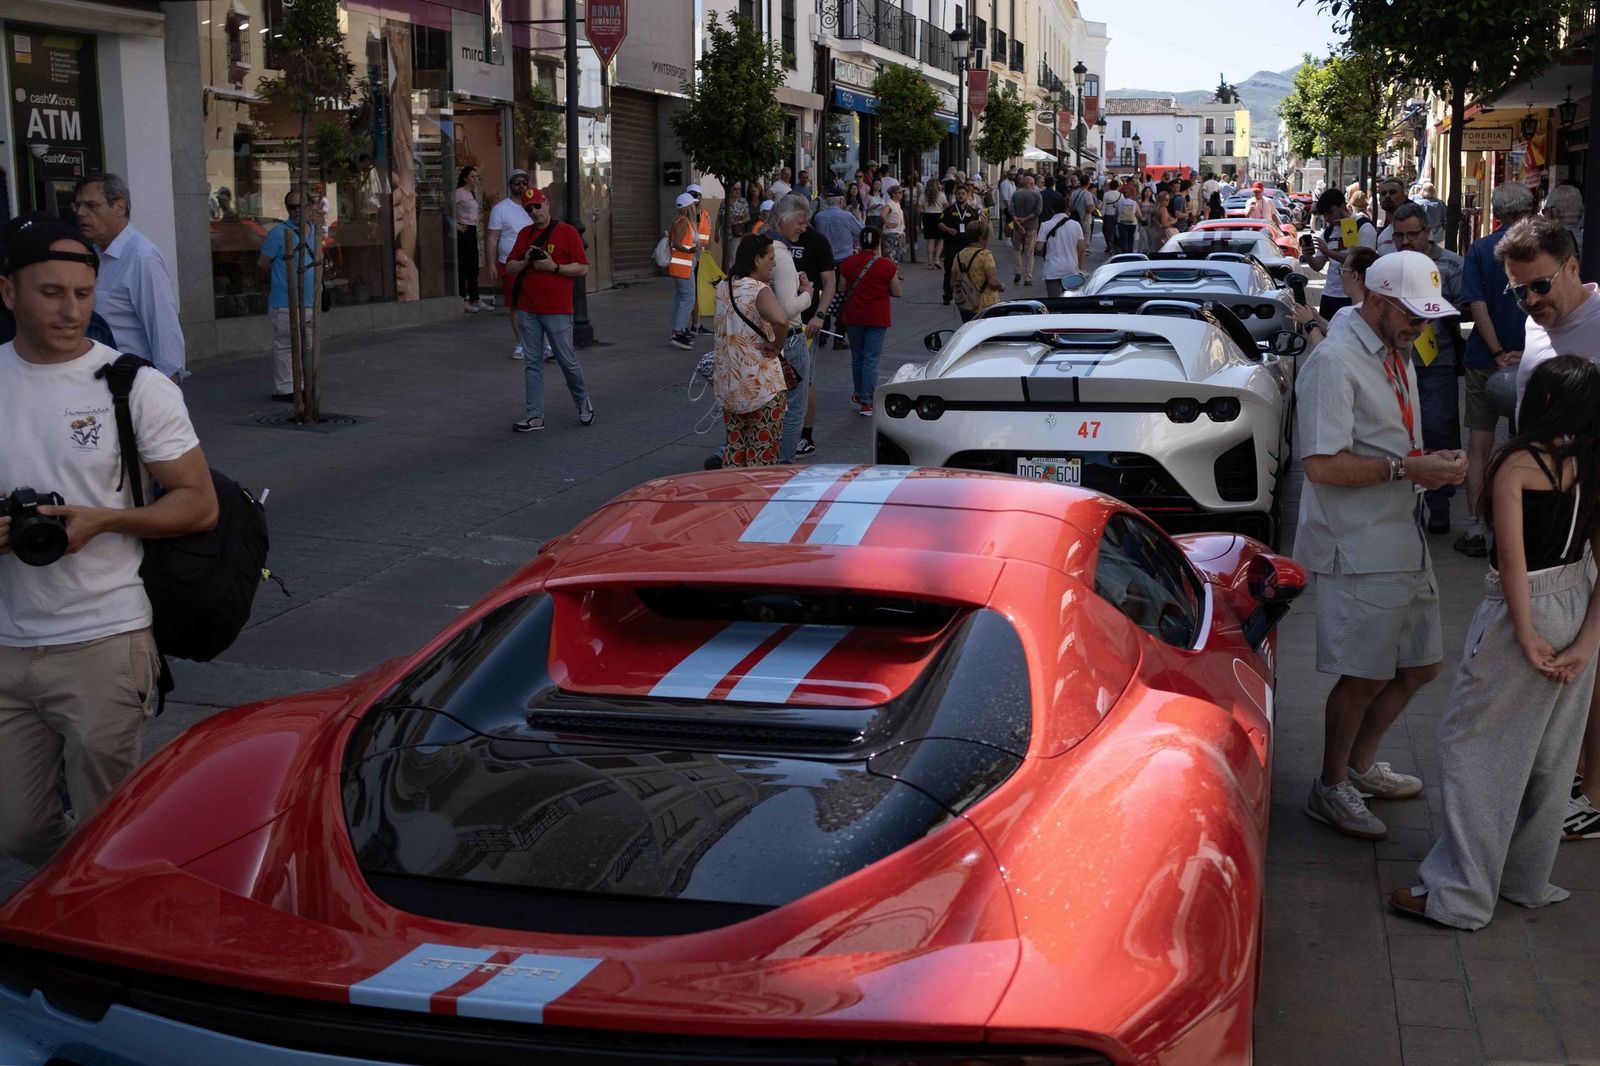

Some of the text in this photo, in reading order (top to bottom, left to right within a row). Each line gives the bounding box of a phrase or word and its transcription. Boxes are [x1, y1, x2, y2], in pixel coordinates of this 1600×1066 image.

[27, 108, 82, 141] ATM
[1424, 302, 1441, 312] 16
[1077, 421, 1102, 439] 47
